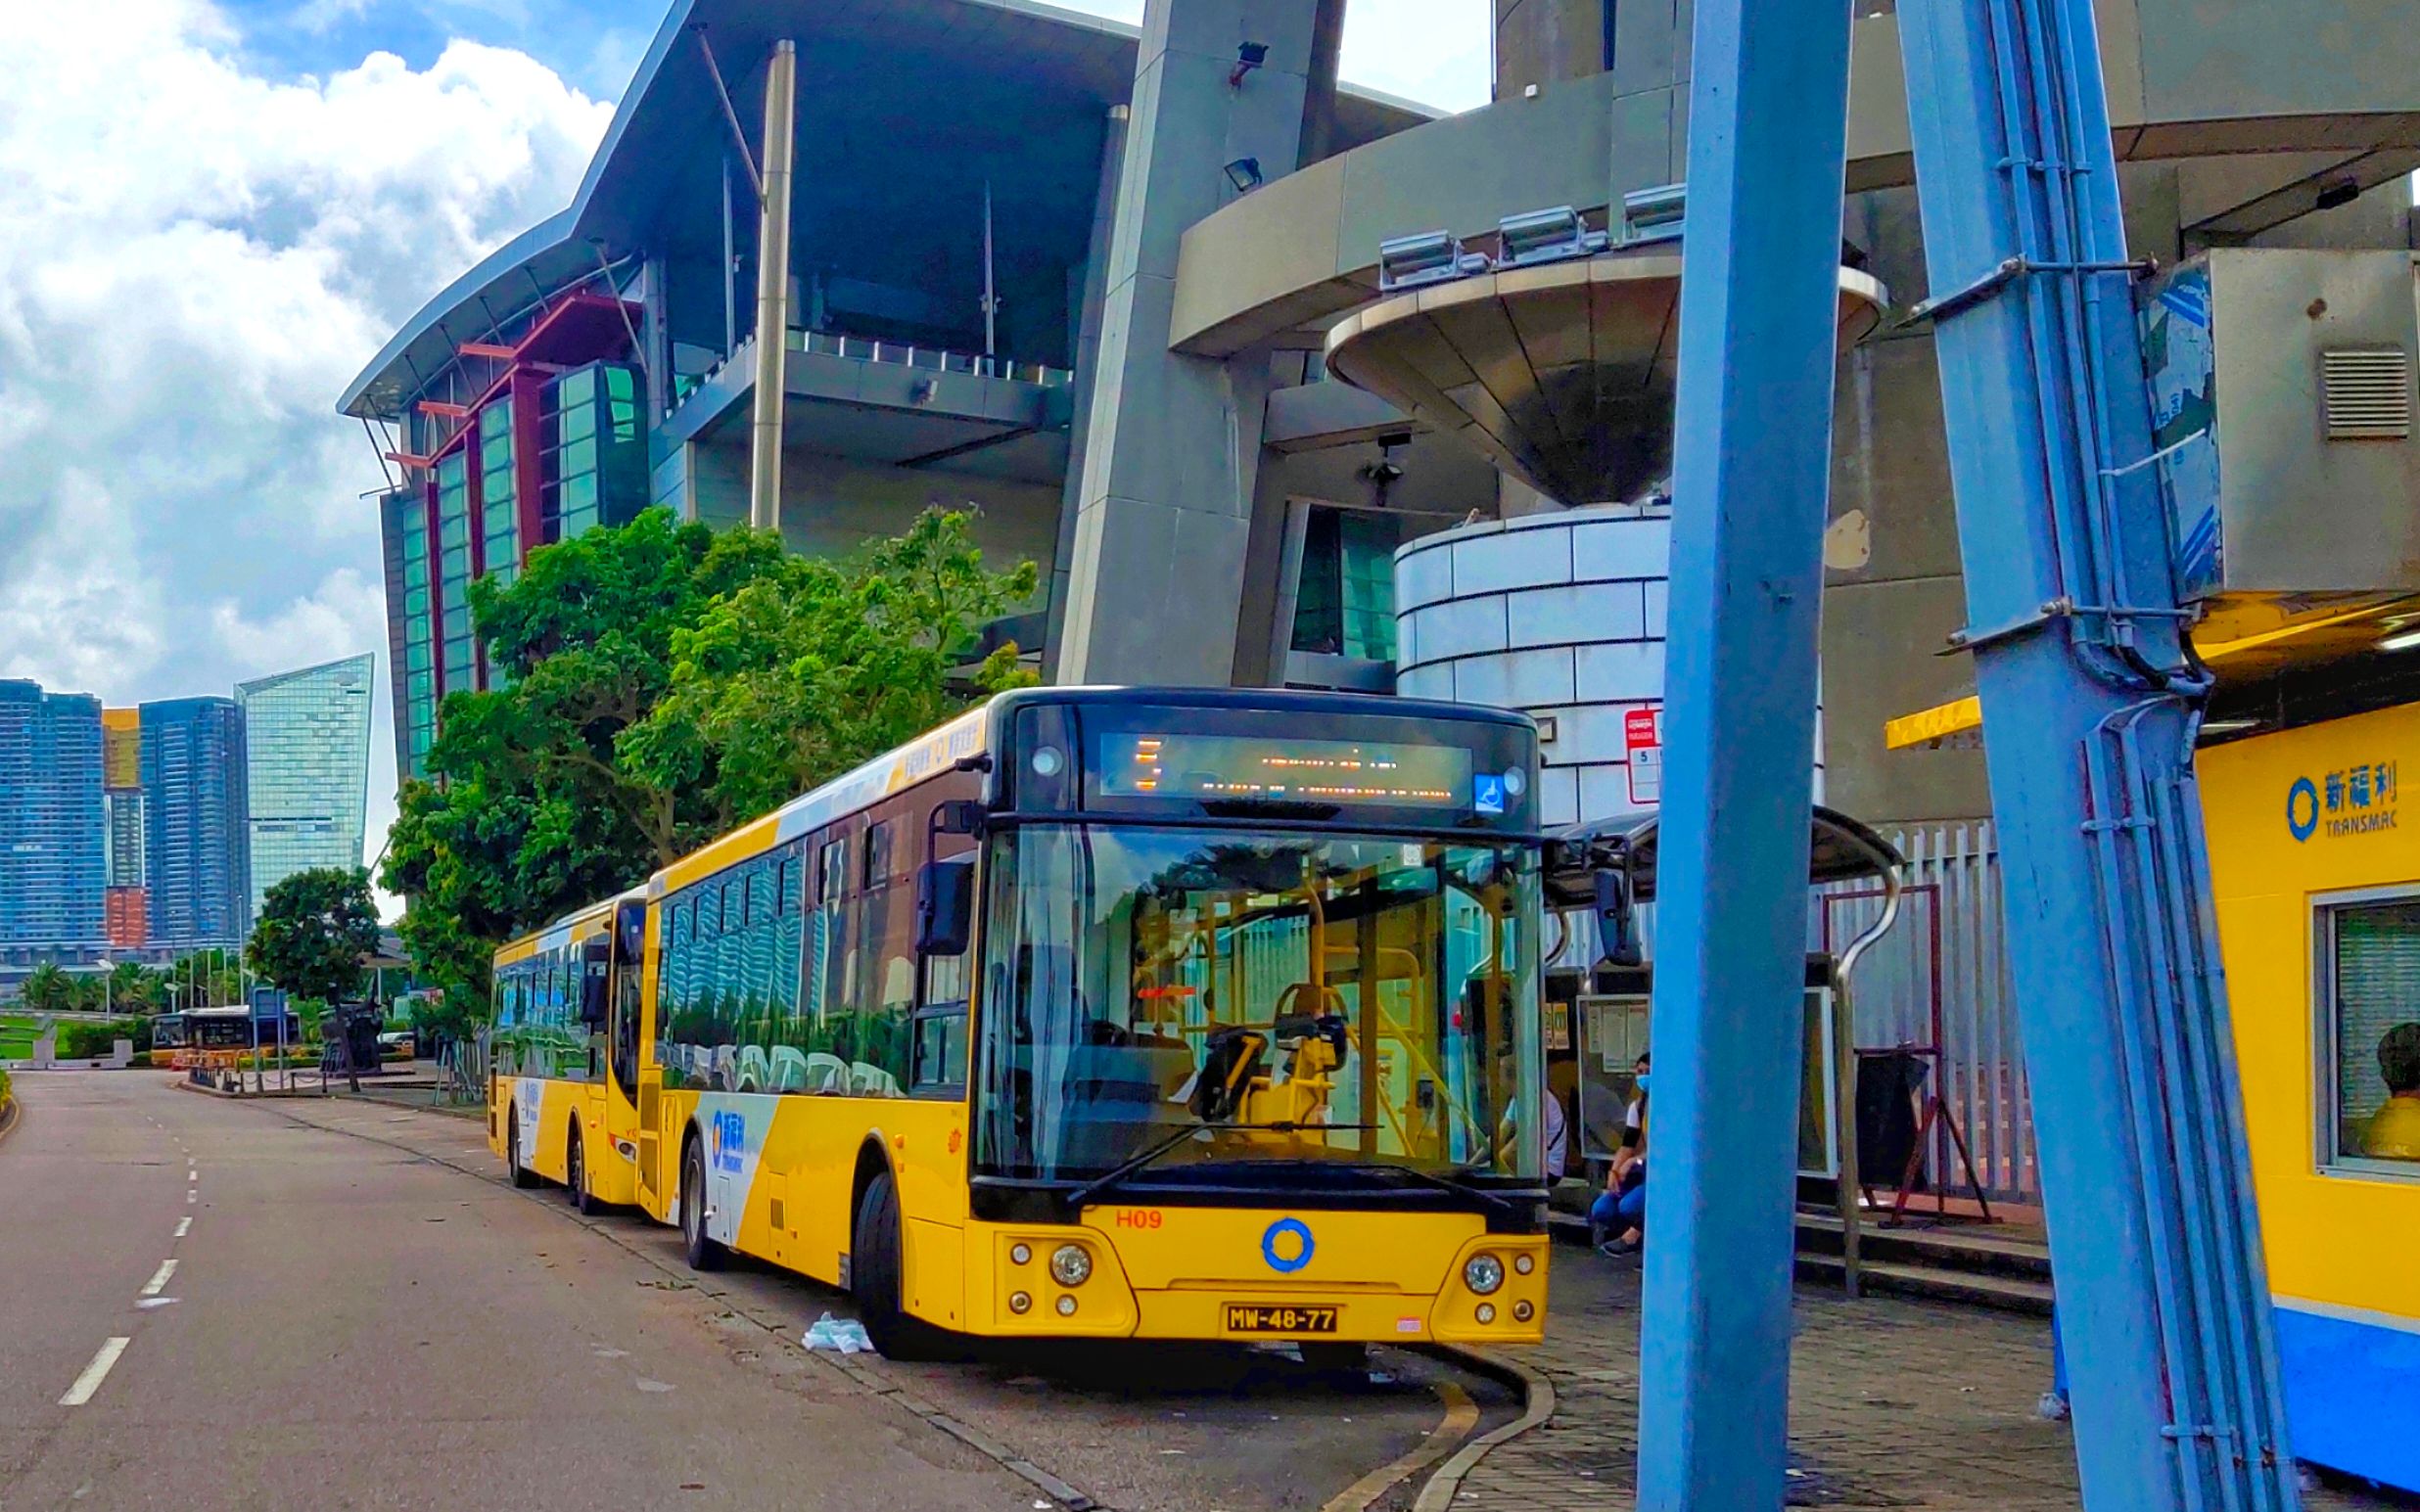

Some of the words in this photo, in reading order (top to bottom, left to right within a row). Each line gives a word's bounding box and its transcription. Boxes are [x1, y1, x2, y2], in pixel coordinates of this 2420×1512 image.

[2325, 759, 2397, 812] 新福利
[2326, 809, 2397, 838] TRANSMAC
[1116, 1210, 1162, 1229] H09
[1231, 1309, 1334, 1329] MW-48-77
